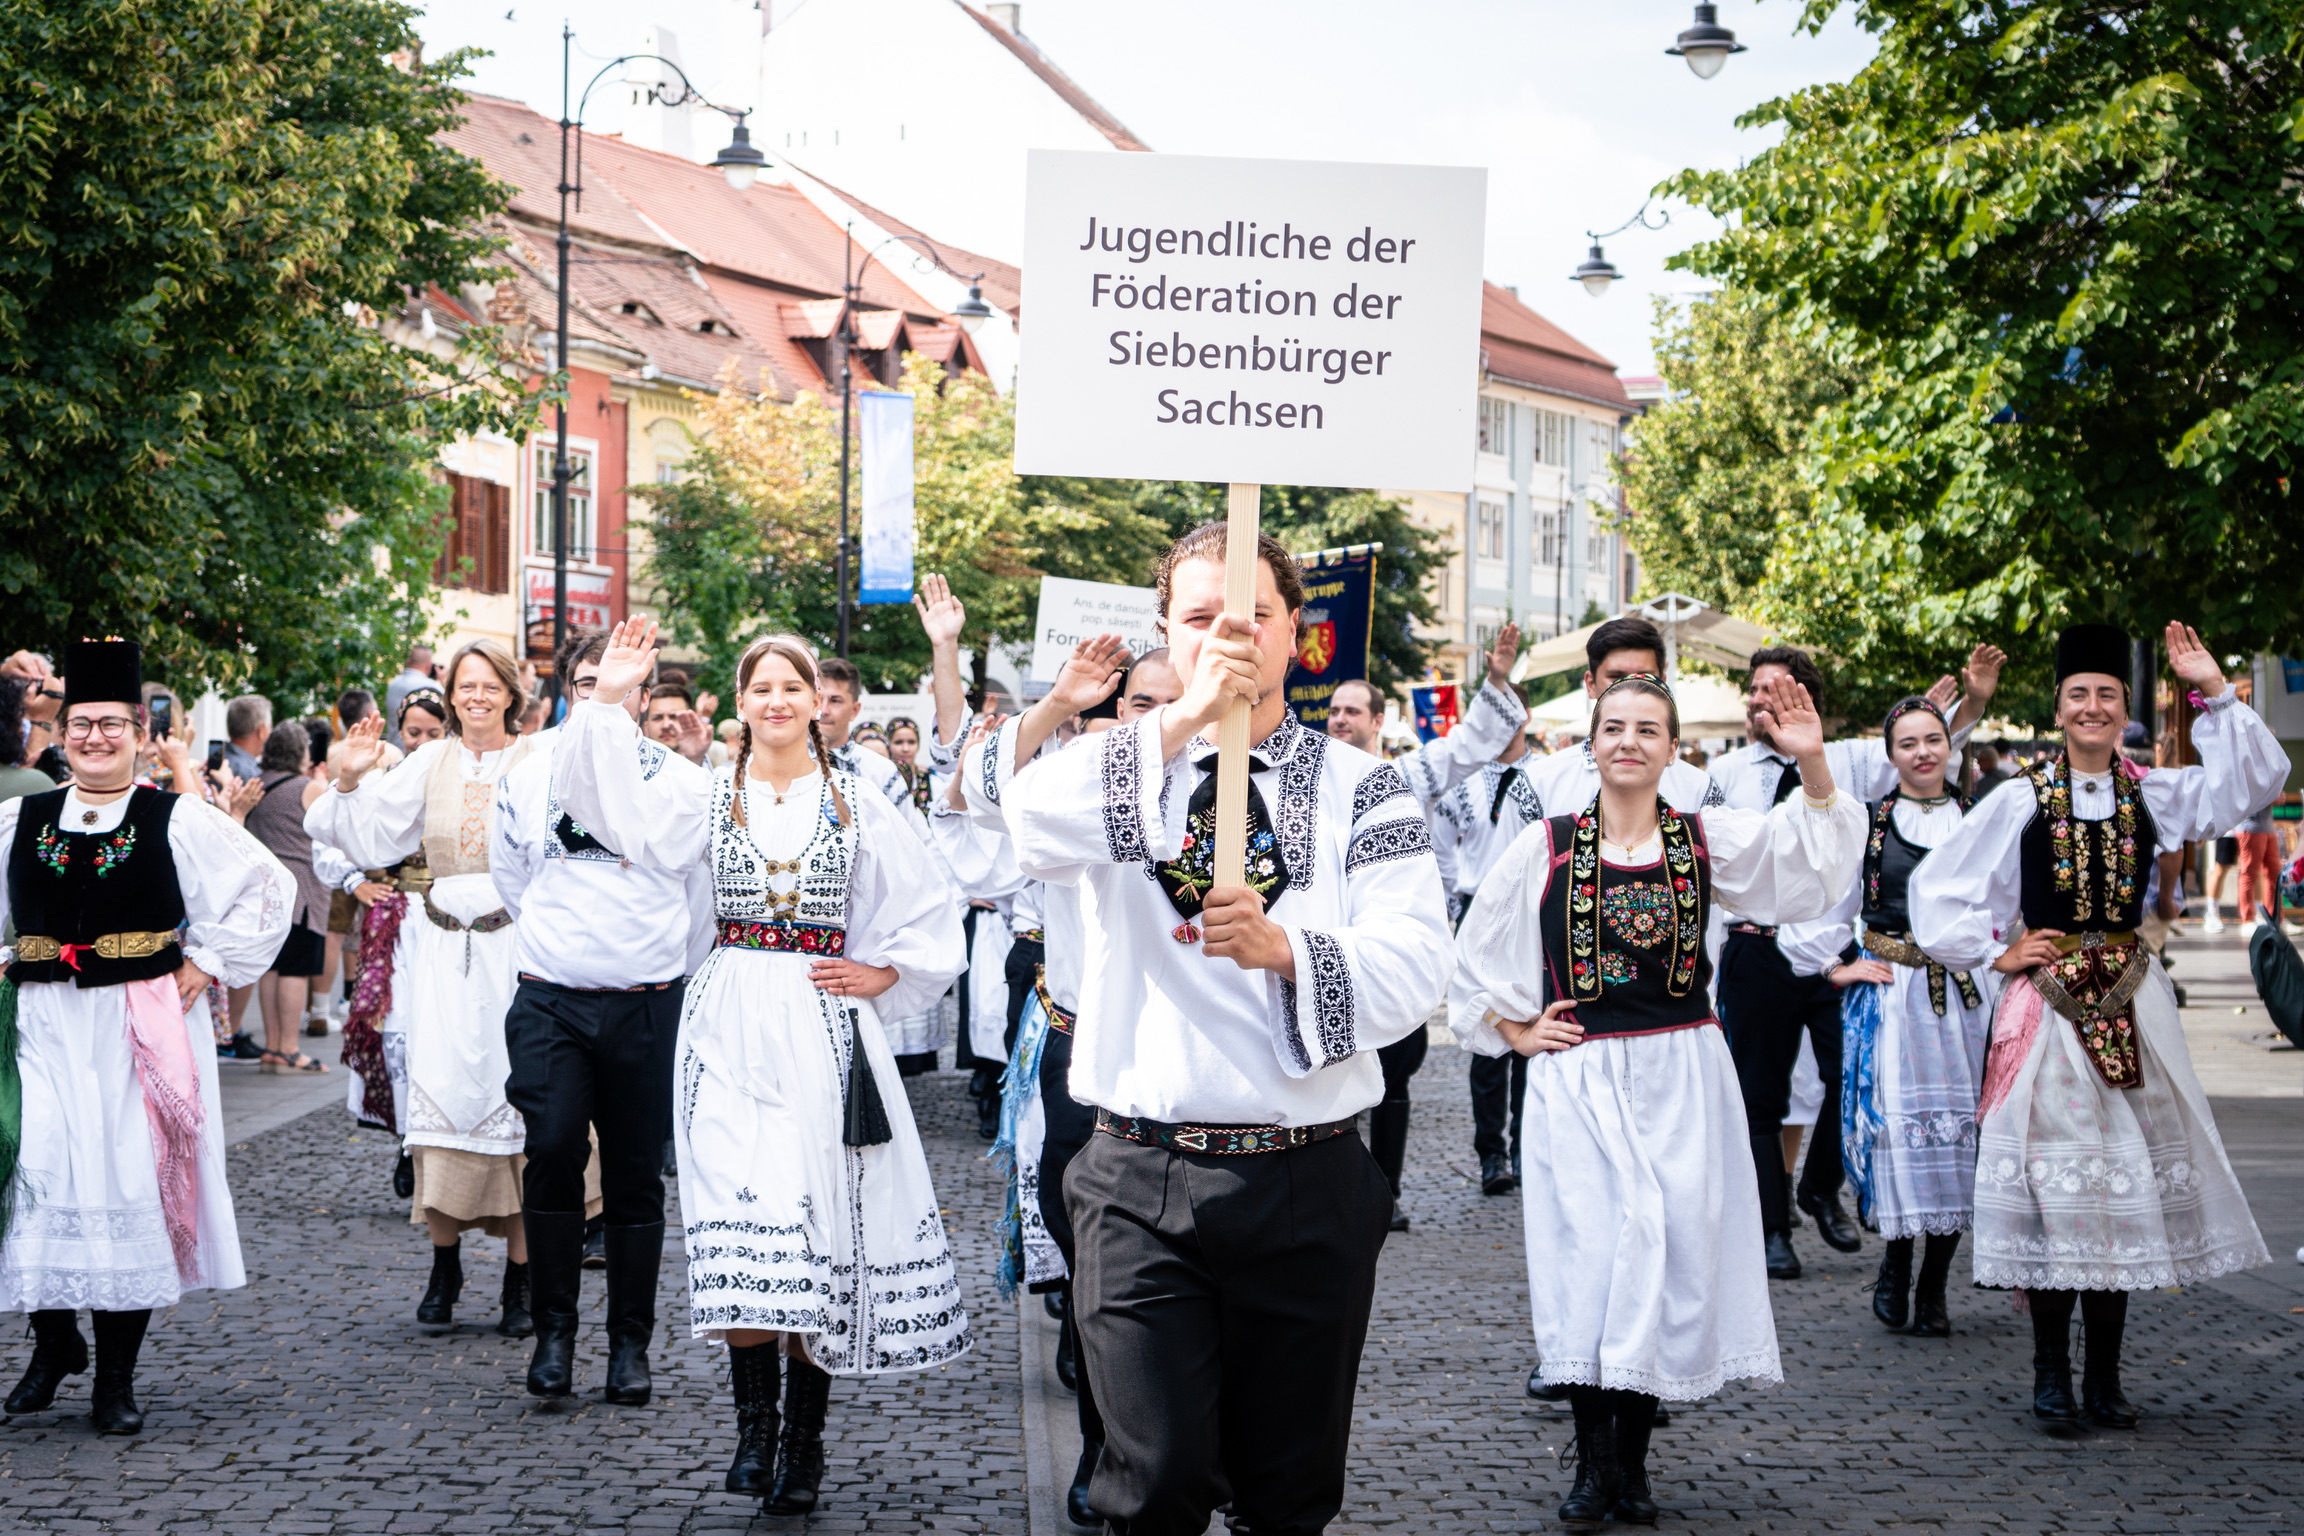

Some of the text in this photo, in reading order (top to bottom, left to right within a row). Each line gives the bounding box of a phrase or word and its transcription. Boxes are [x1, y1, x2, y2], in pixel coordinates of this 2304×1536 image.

[1079, 216, 1416, 264] Jugendliche der
[1091, 273, 1403, 320] Föderation der
[1108, 330, 1392, 385] Siebenbürger
[1156, 388, 1324, 430] Sachsen
[1098, 601, 1111, 611] de
[1114, 603, 1154, 616] dansuri
[1303, 580, 1346, 602] gruppe
[1080, 614, 1106, 626] pop.
